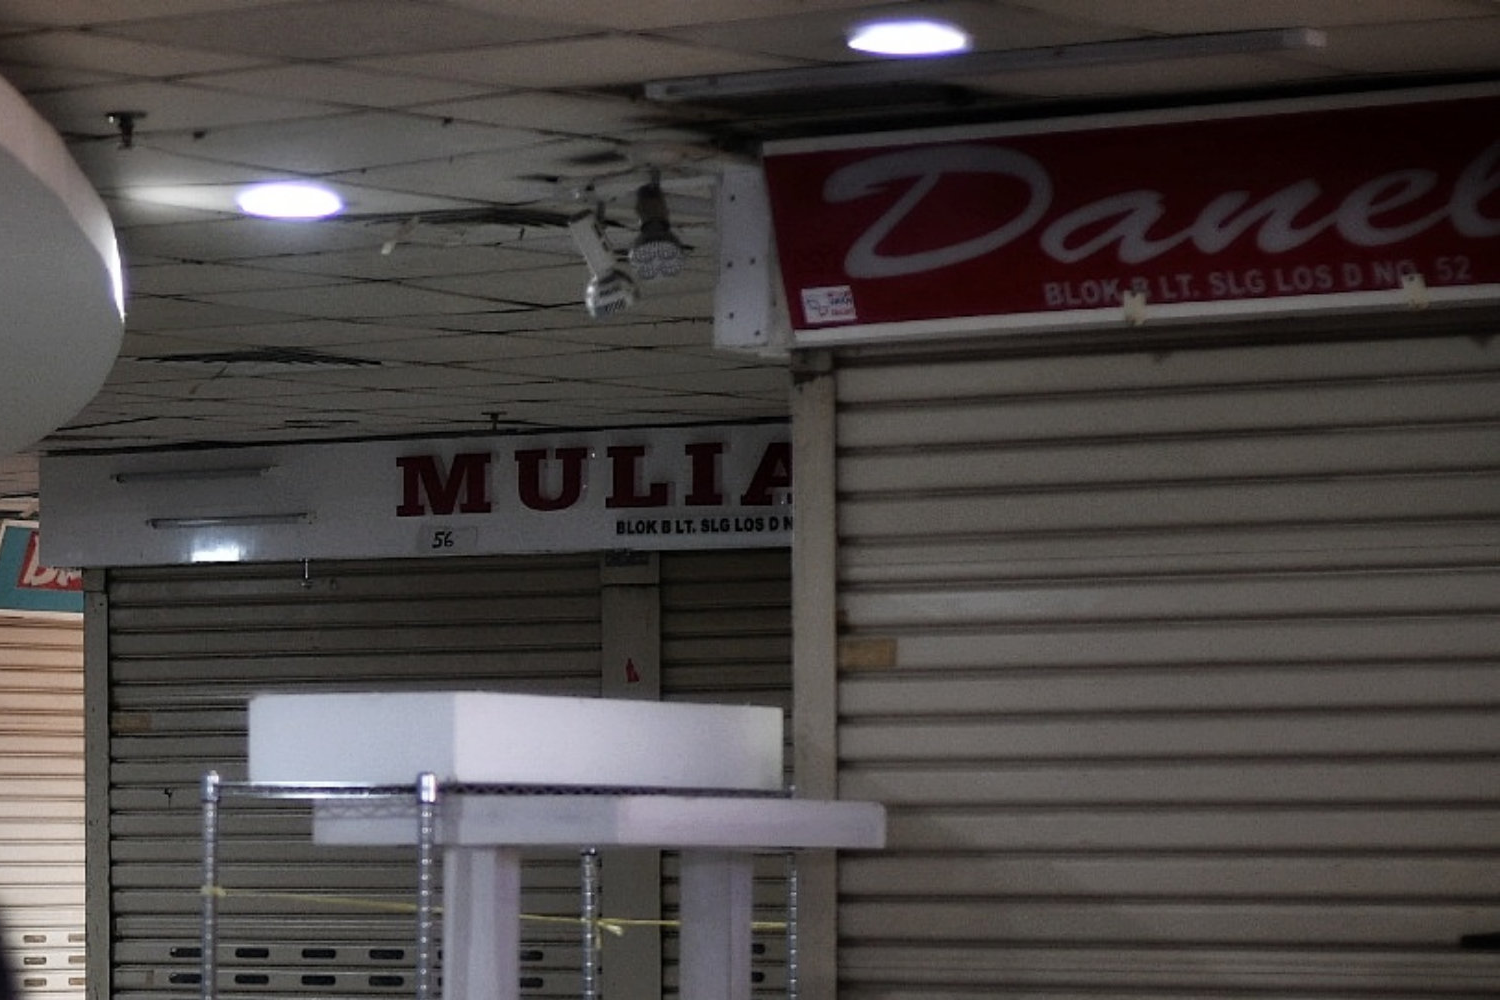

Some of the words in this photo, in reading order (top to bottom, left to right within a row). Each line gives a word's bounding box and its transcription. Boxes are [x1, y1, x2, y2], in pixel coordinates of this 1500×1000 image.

[1043, 280, 1119, 306] BLOK
[1159, 273, 1199, 300] LT.
[1208, 268, 1267, 297] SLG
[1274, 264, 1335, 292] LOS
[1342, 262, 1364, 287] D
[1435, 254, 1472, 281] 52
[395, 442, 793, 519] MULIA
[432, 531, 456, 550] 56
[615, 519, 658, 535] BLOK
[661, 519, 671, 534] B
[675, 519, 697, 534] LT.
[700, 518, 731, 533] SLG
[735, 517, 765, 532] LOS
[769, 516, 780, 531] D
